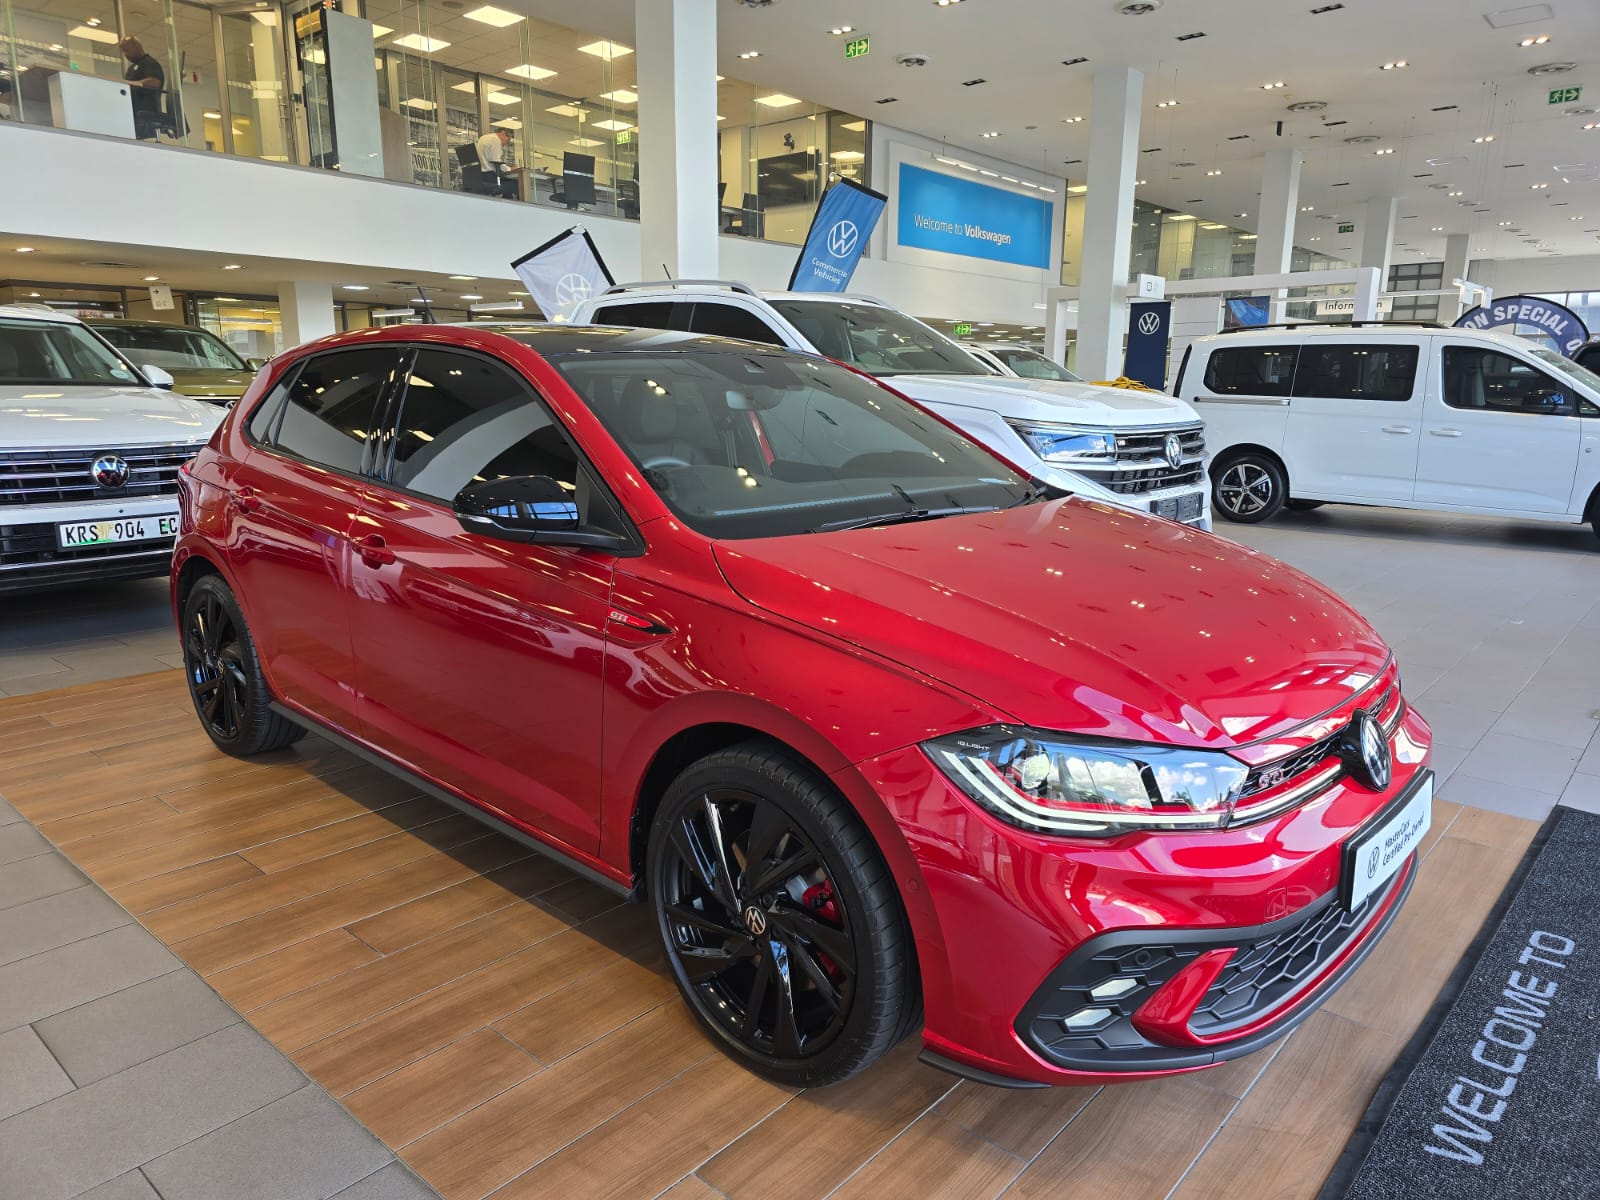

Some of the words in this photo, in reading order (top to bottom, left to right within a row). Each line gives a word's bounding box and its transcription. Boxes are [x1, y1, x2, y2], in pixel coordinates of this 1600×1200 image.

[914, 215, 953, 234] Welcome
[955, 224, 962, 235] to
[964, 223, 1011, 245] Volkswagen
[1493, 304, 1569, 336] SPECIAL
[65, 524, 99, 545] KRS
[114, 521, 145, 539] 904
[159, 517, 178, 535] EC
[1258, 768, 1285, 789] GTI
[1423, 969, 1559, 1167] WELCOME
[1518, 929, 1576, 970] TO
